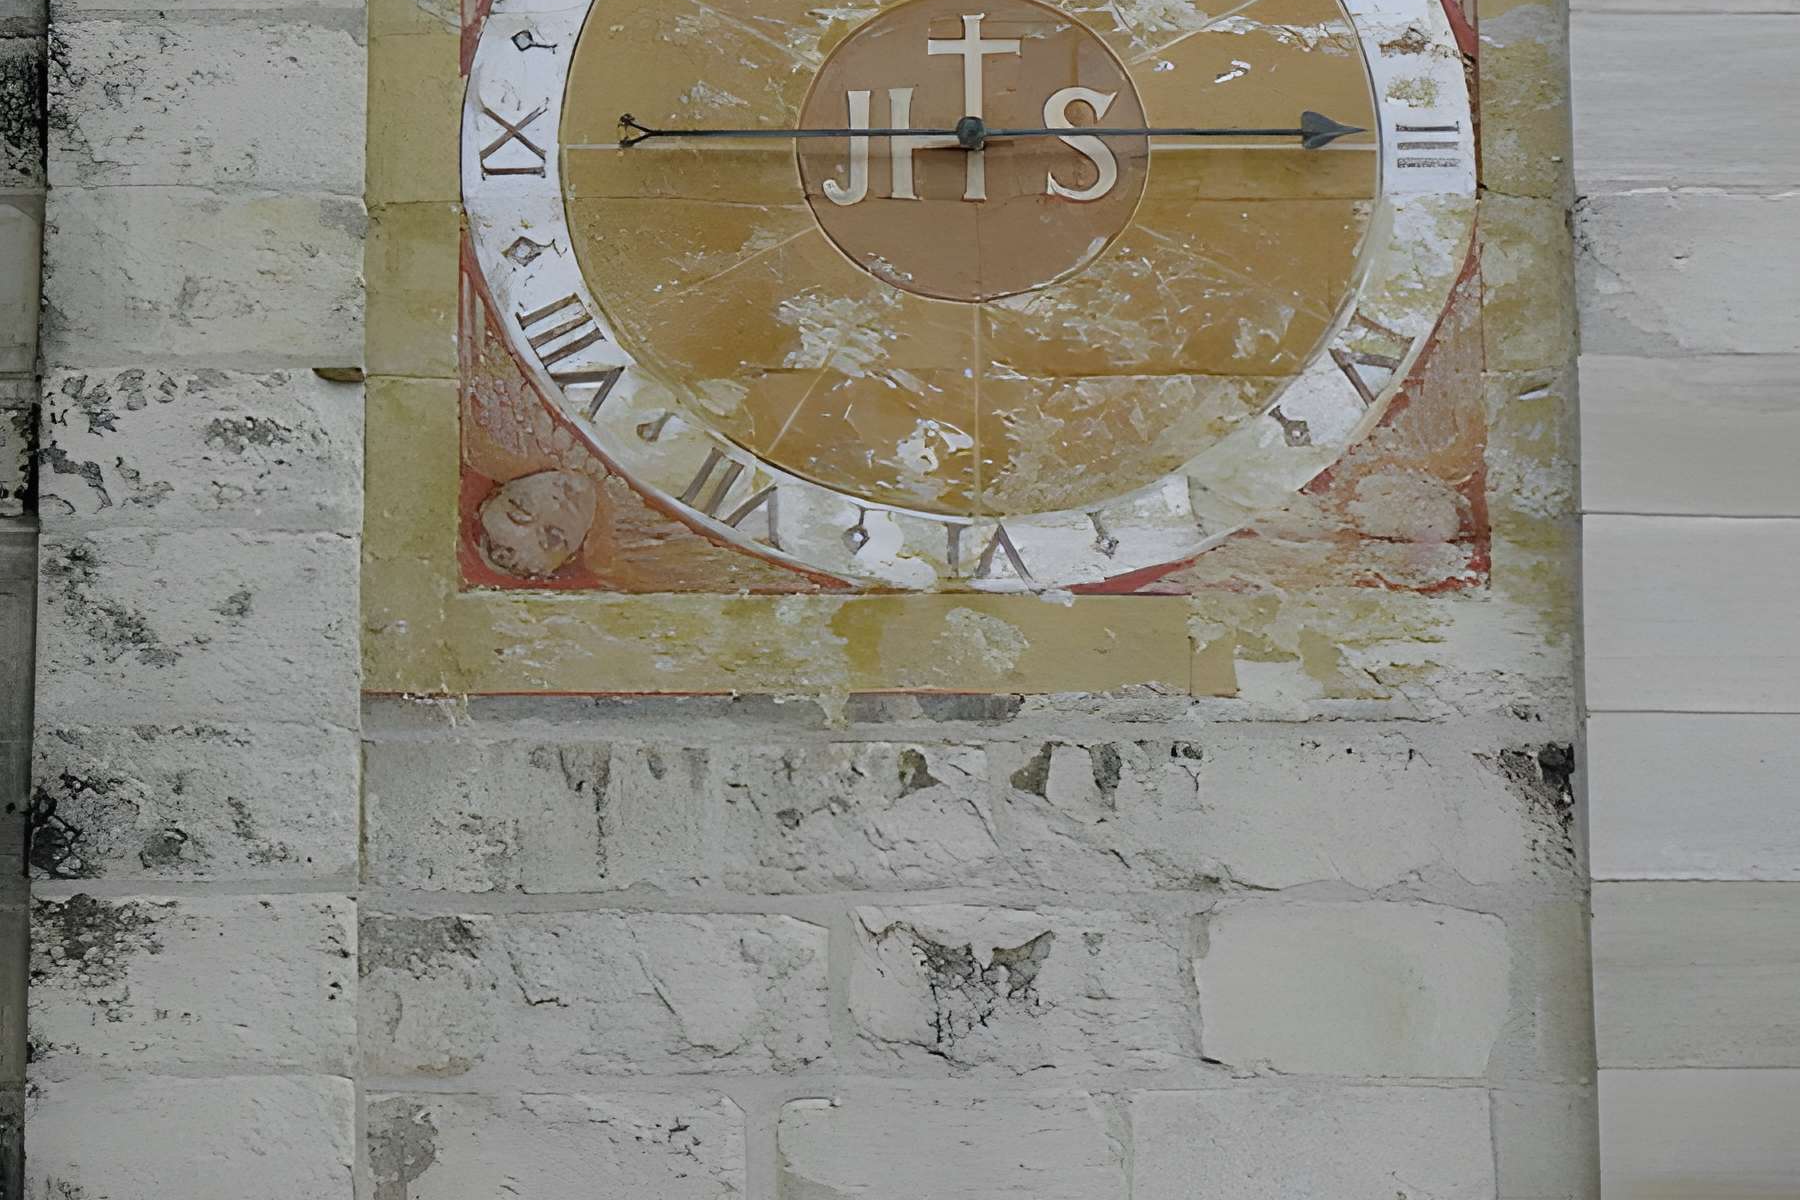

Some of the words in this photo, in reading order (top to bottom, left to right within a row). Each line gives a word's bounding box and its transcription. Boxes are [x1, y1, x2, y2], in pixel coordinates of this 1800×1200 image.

[479, 97, 550, 181] IX
[1395, 120, 1461, 169] III
[515, 292, 627, 424] VIII
[676, 446, 784, 552] VII
[943, 521, 1044, 596] VI
